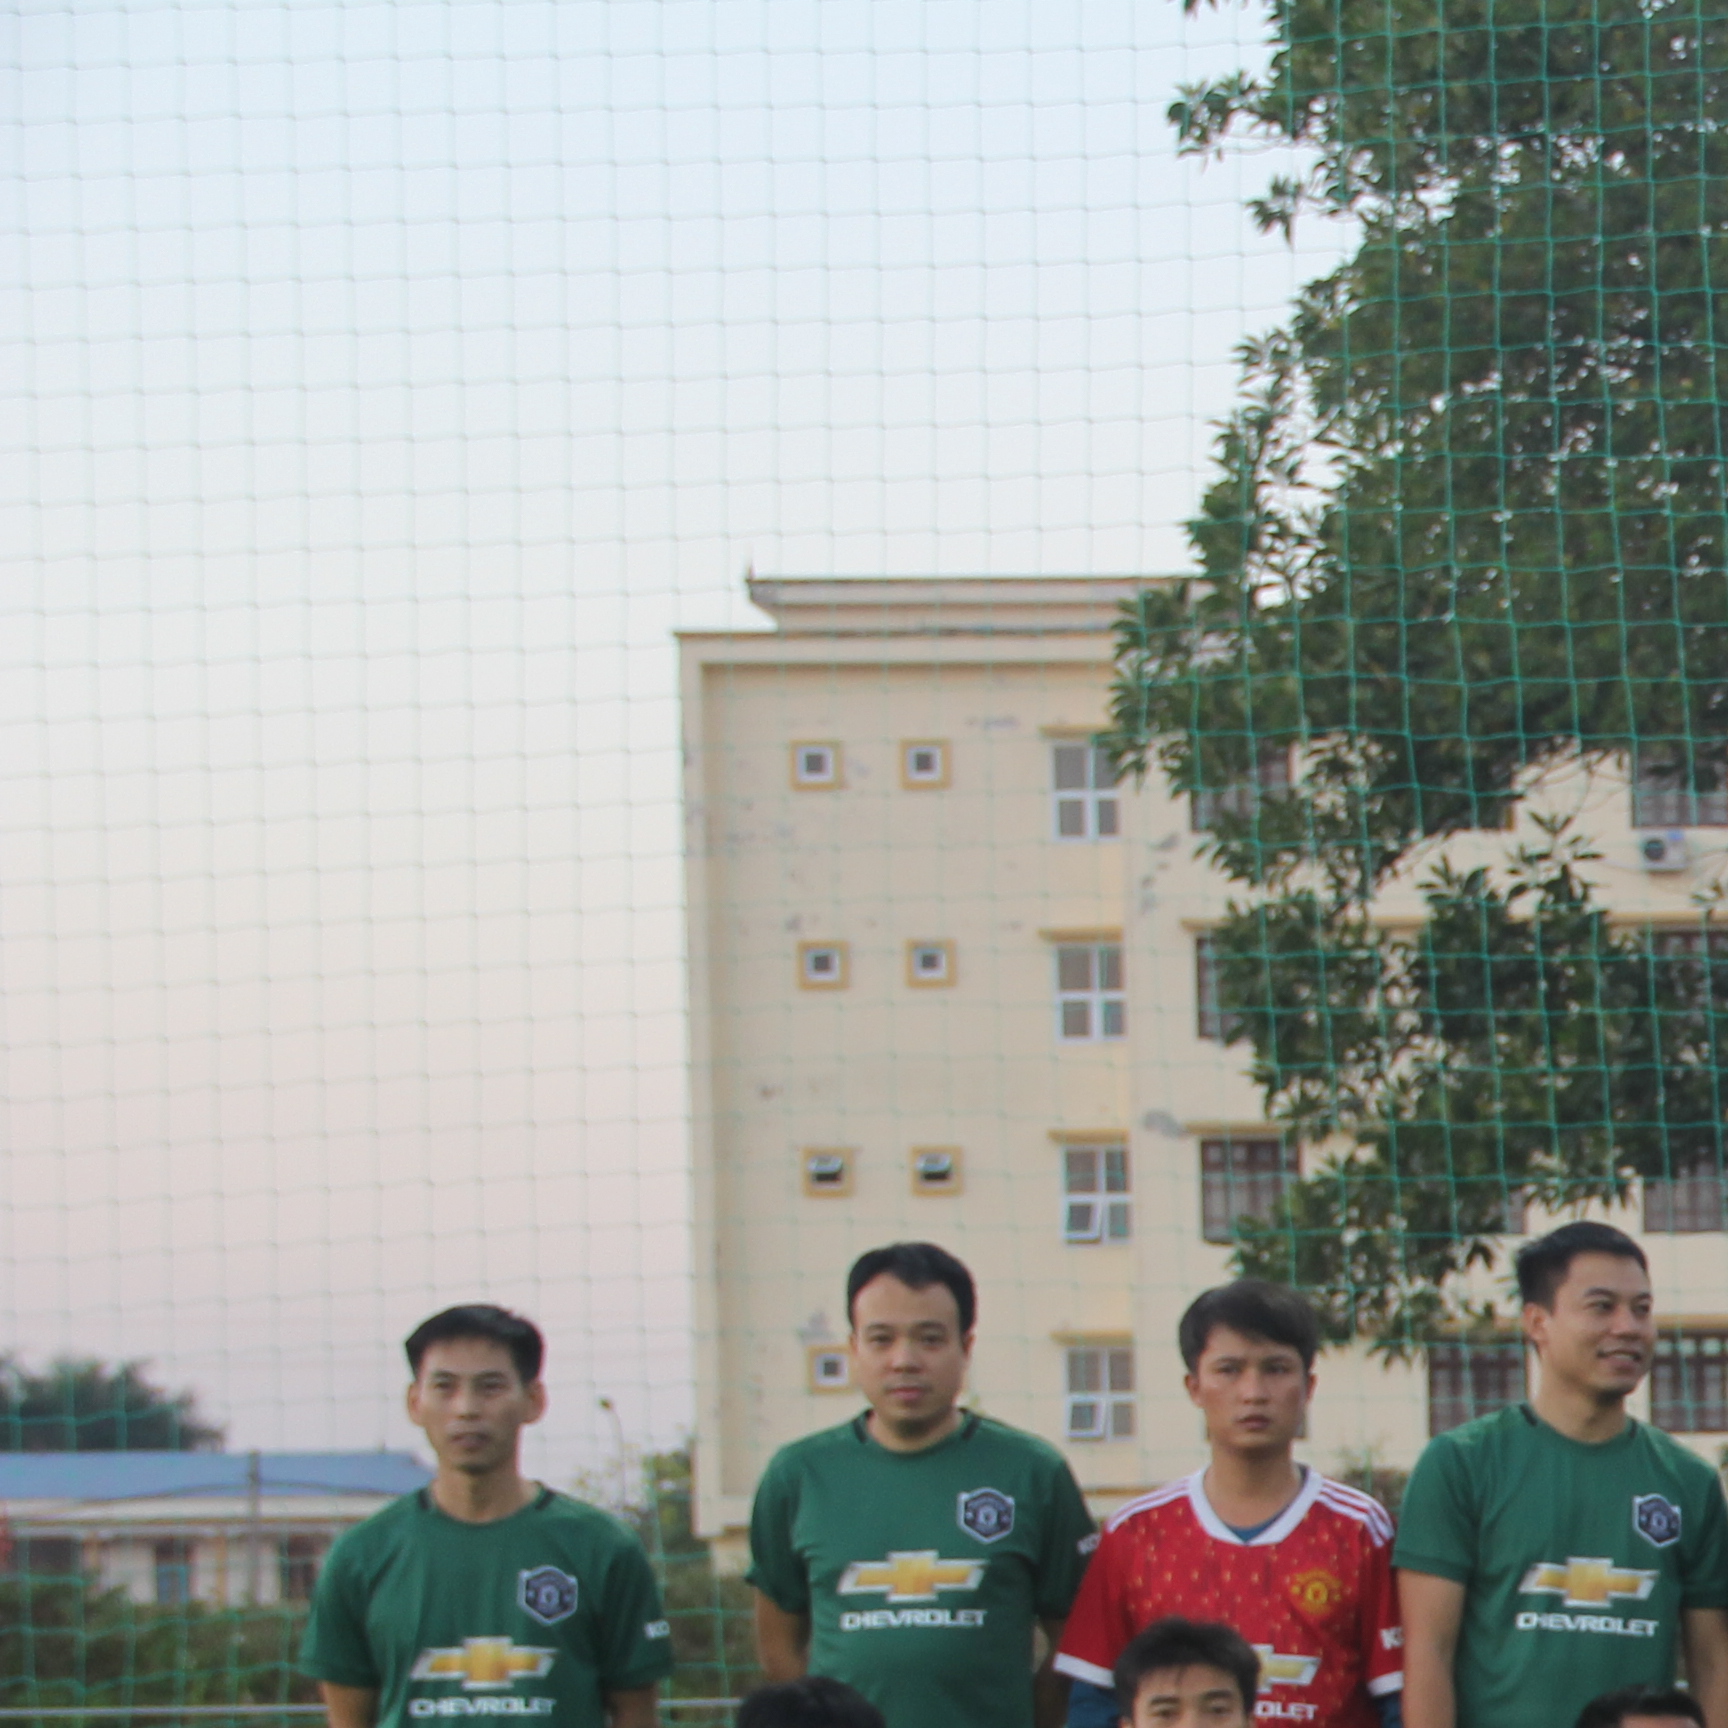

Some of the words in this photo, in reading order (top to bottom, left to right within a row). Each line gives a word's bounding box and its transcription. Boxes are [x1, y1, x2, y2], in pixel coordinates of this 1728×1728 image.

[840, 1609, 988, 1631] CHEVROLET
[1516, 1612, 1659, 1637] CHEVROLET
[409, 1697, 557, 1718] CHEVROLET
